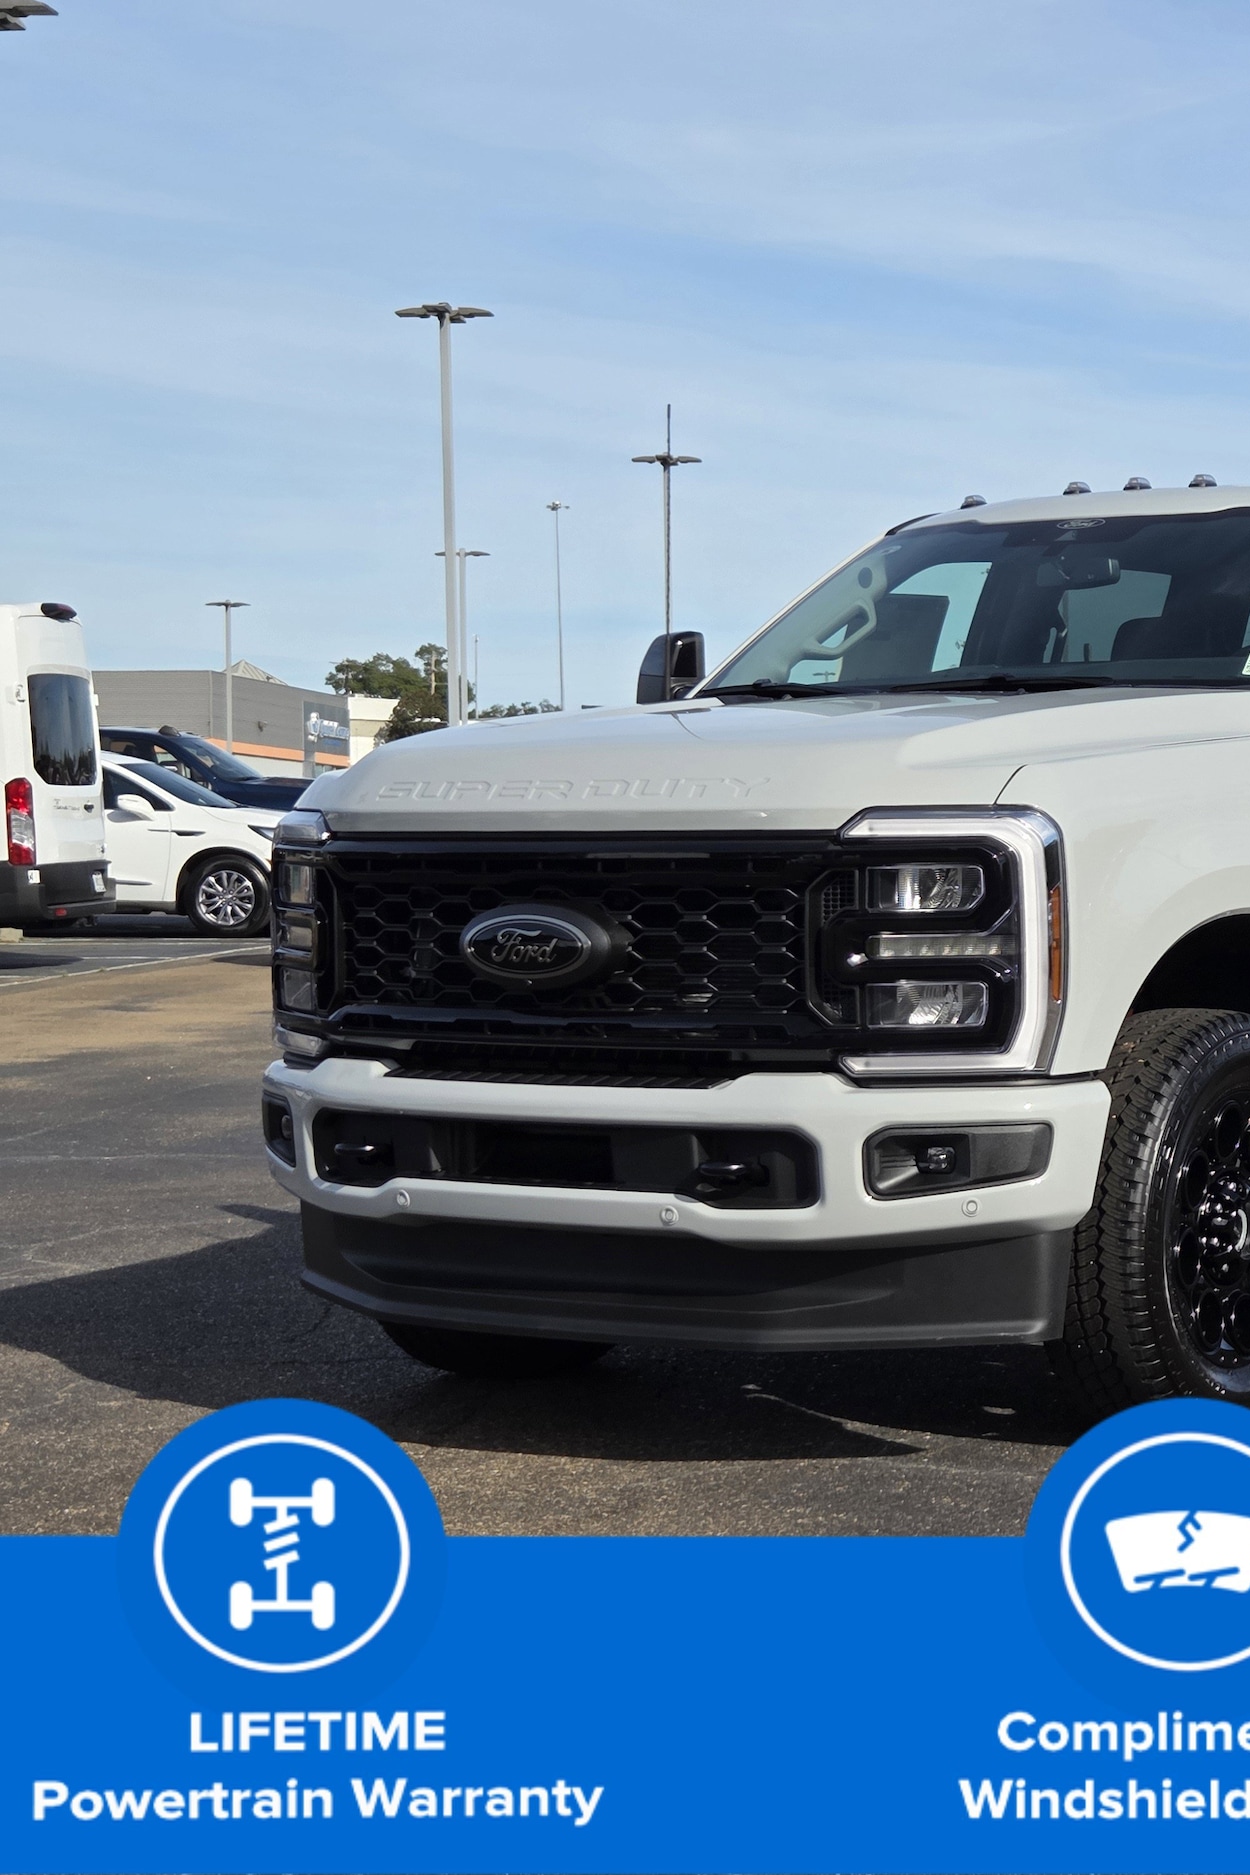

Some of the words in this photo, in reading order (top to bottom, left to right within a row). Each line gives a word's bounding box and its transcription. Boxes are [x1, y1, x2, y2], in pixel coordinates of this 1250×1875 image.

[376, 779, 575, 801] SUPER
[581, 777, 771, 800] DUTY
[491, 928, 559, 963] Ford
